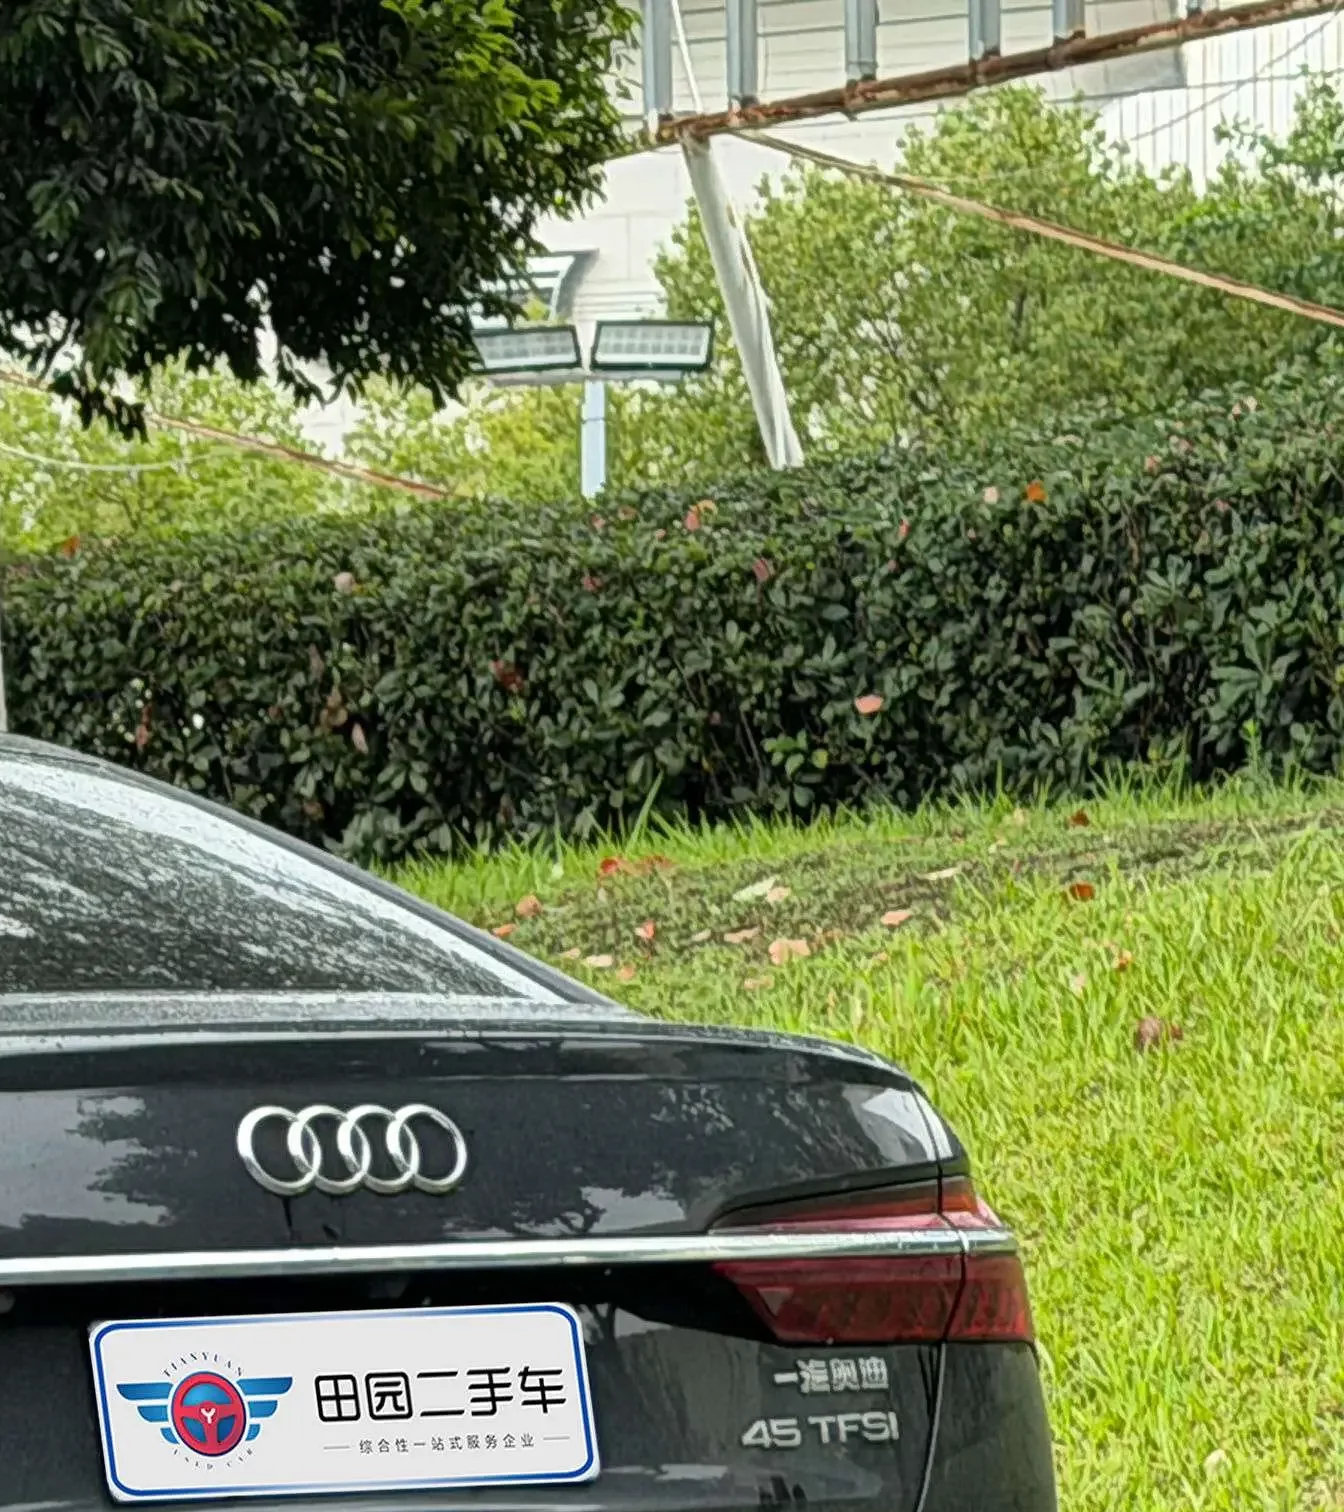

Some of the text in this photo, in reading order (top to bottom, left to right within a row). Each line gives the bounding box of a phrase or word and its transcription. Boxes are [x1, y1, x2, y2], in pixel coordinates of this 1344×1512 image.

[773, 1356, 889, 1394] 一汽奥迪
[740, 1411, 900, 1449] 45 TFSI
